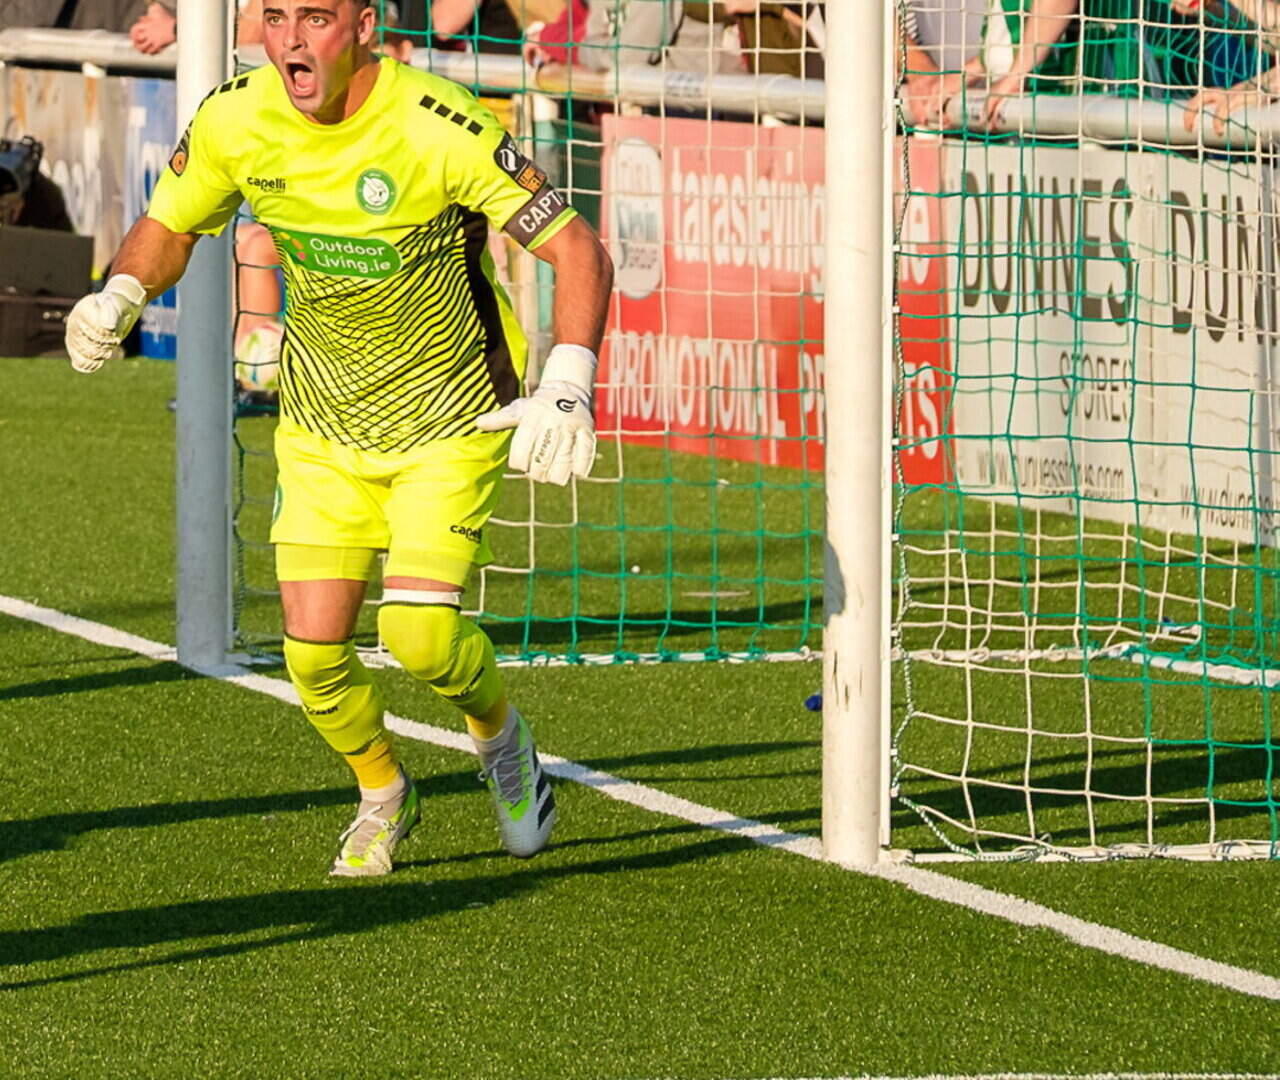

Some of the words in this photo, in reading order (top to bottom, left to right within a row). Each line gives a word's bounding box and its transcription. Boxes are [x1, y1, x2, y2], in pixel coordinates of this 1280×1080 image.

[247, 176, 287, 190] capelli
[310, 238, 385, 257] Outdoor
[960, 171, 1134, 327] DUNNES
[314, 254, 391, 274] Living.ie
[607, 328, 786, 440] PROMOTIONAL
